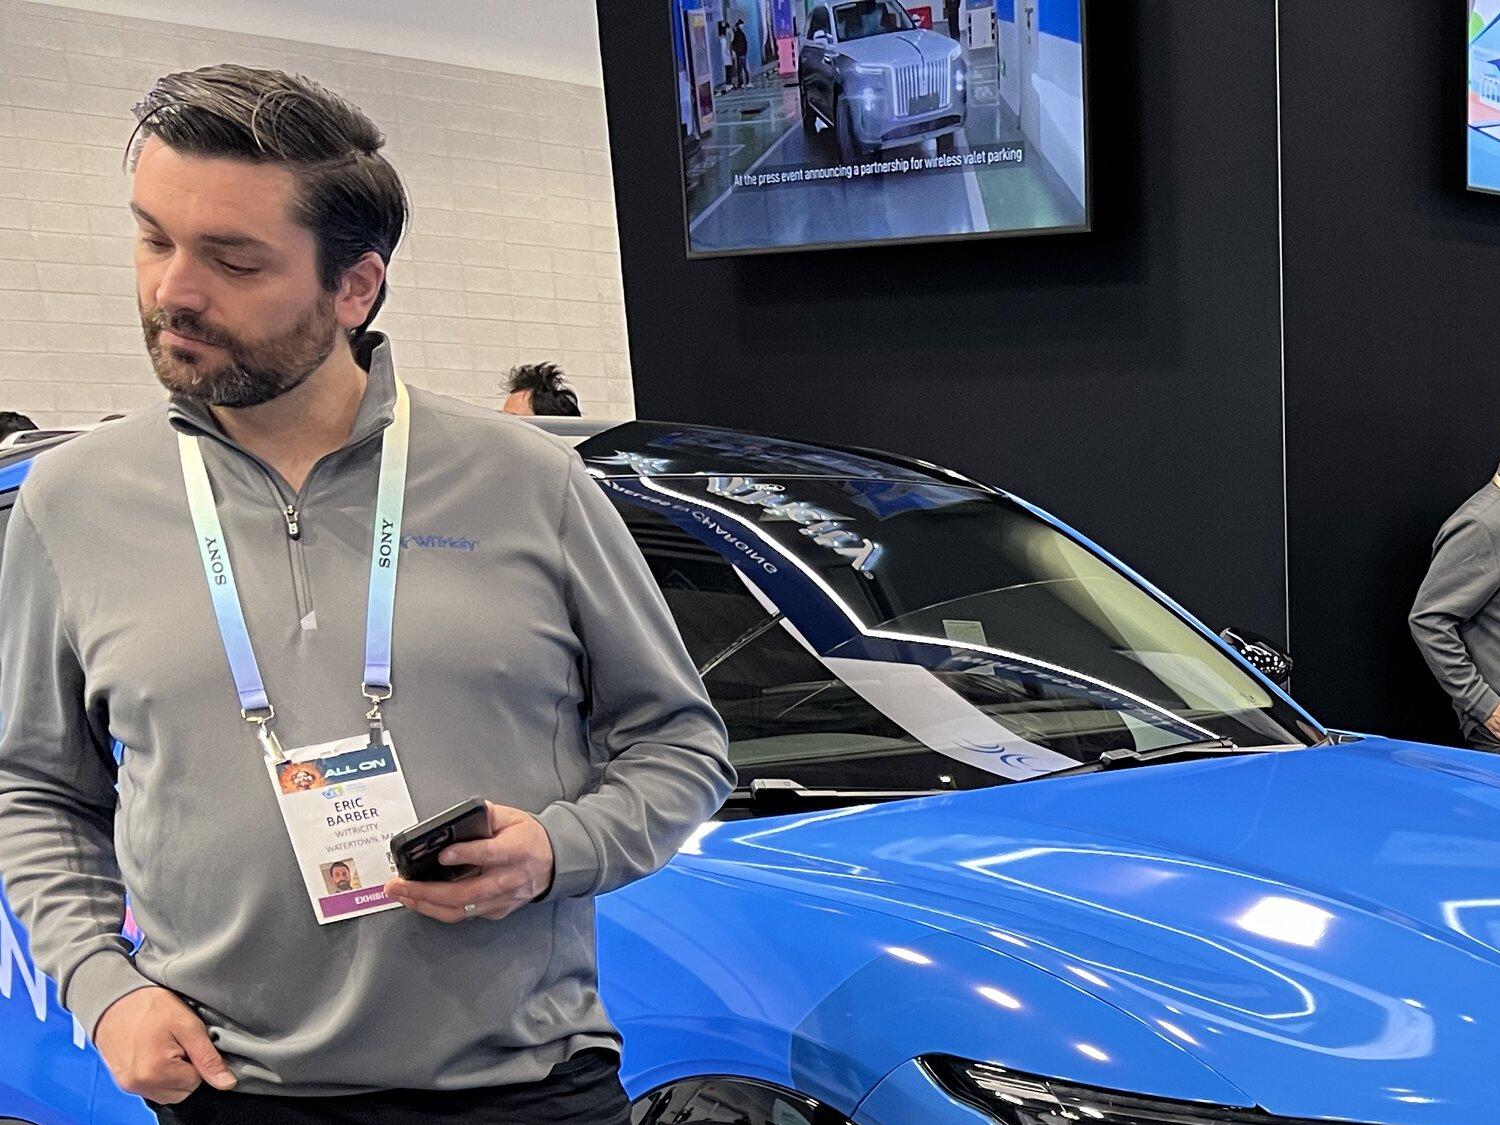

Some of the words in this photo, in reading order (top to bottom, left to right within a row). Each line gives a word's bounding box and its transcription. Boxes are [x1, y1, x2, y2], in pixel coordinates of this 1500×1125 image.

[733, 174, 743, 186] At
[744, 173, 757, 186] the
[758, 173, 780, 187] press
[781, 169, 803, 183] event
[804, 165, 852, 180] announcing
[853, 165, 859, 176] a
[860, 158, 909, 177] partnership
[910, 156, 923, 170] for
[924, 153, 962, 168] wireless
[963, 150, 986, 165] valet
[987, 148, 1023, 165] parking
[379, 518, 394, 568] SONY
[205, 536, 227, 586] SONY
[324, 765, 358, 779] ALL
[358, 758, 387, 771] ON
[334, 797, 364, 813] ERIC
[326, 807, 379, 827] BARBER
[334, 823, 378, 838] WITRICITY
